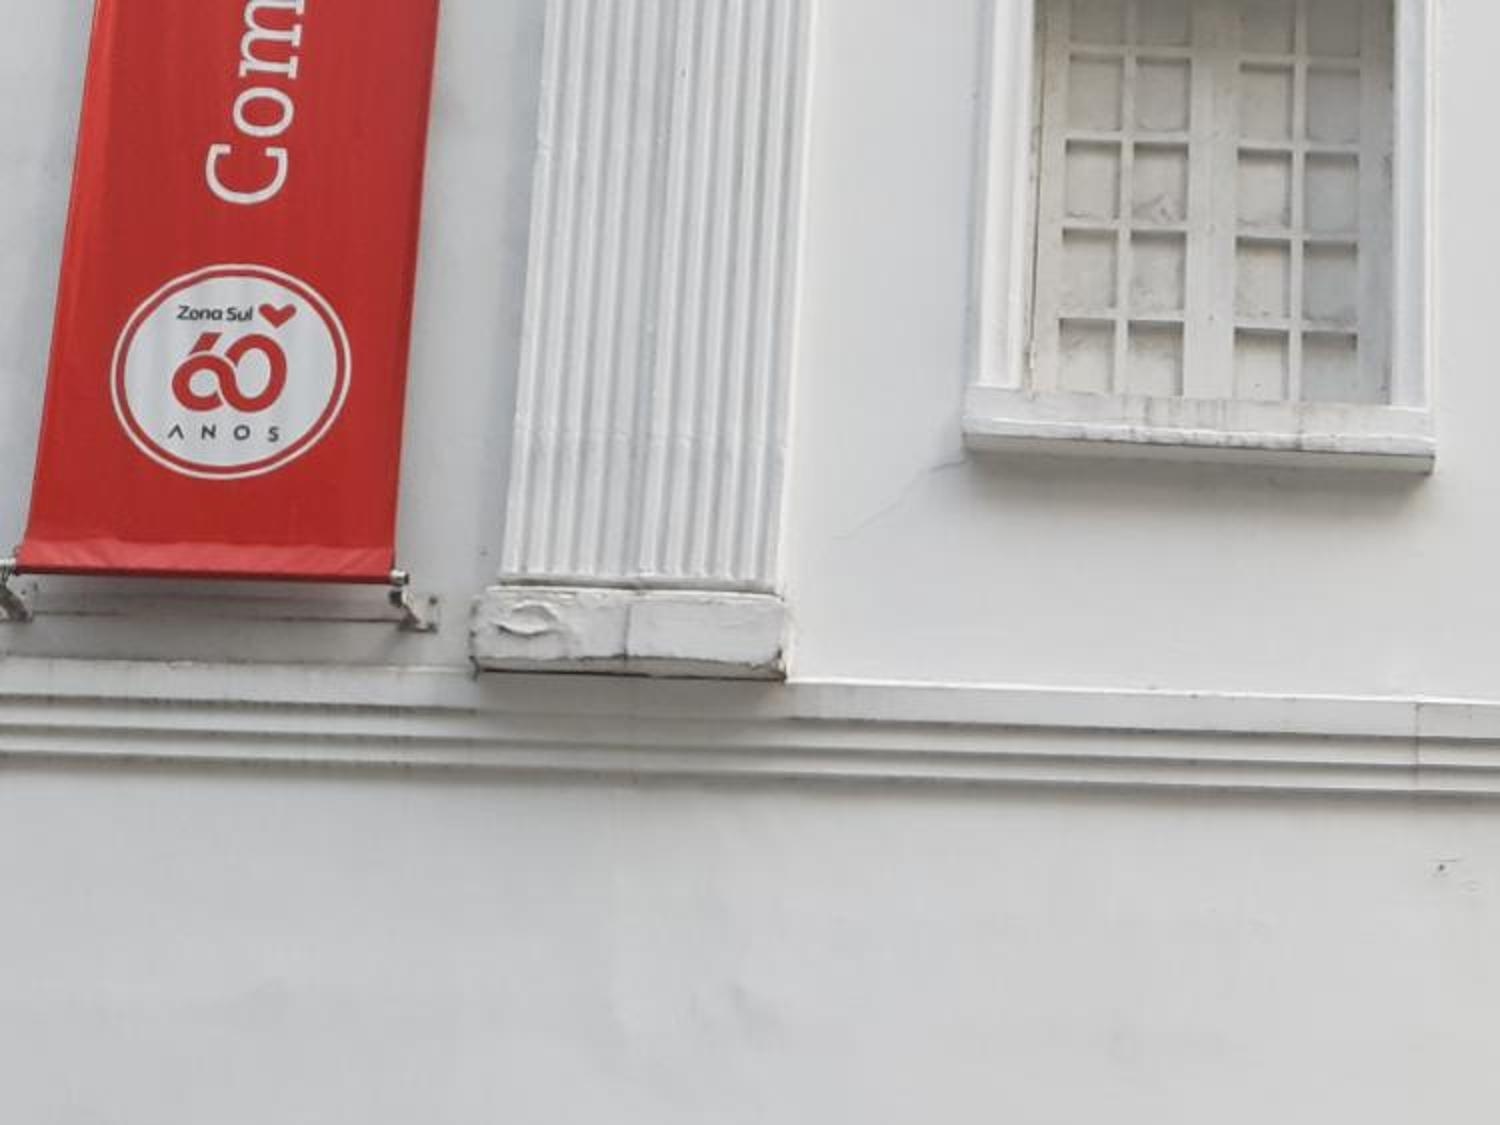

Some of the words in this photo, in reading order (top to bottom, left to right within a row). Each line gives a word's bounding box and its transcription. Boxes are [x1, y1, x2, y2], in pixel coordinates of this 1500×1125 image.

[176, 304, 223, 321] Zona
[226, 305, 253, 321] Sul
[172, 332, 287, 413] 60
